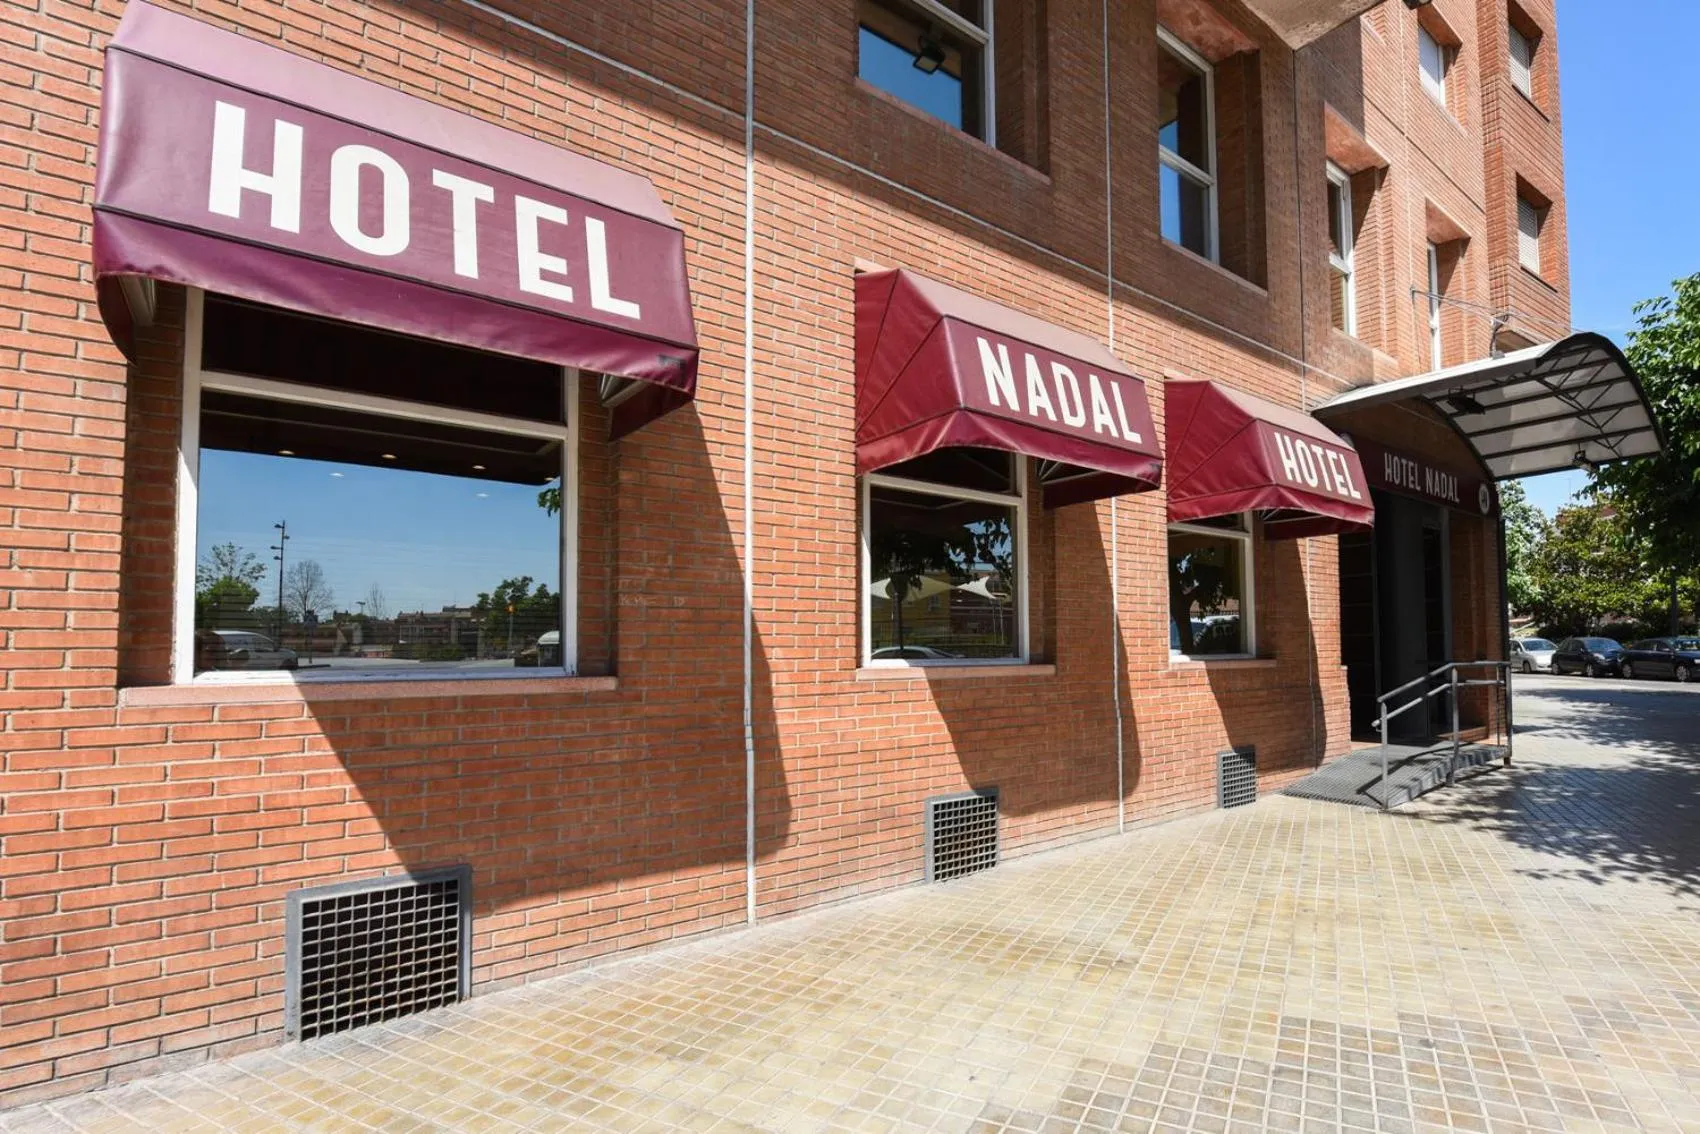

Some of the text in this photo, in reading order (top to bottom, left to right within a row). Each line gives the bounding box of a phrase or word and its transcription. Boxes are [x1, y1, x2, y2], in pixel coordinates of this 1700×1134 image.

[208, 100, 641, 320] HOTEL
[976, 336, 1142, 444] NADAL
[1273, 431, 1362, 500] HOTEL
[1384, 452, 1460, 503] HOTEL NADAL
